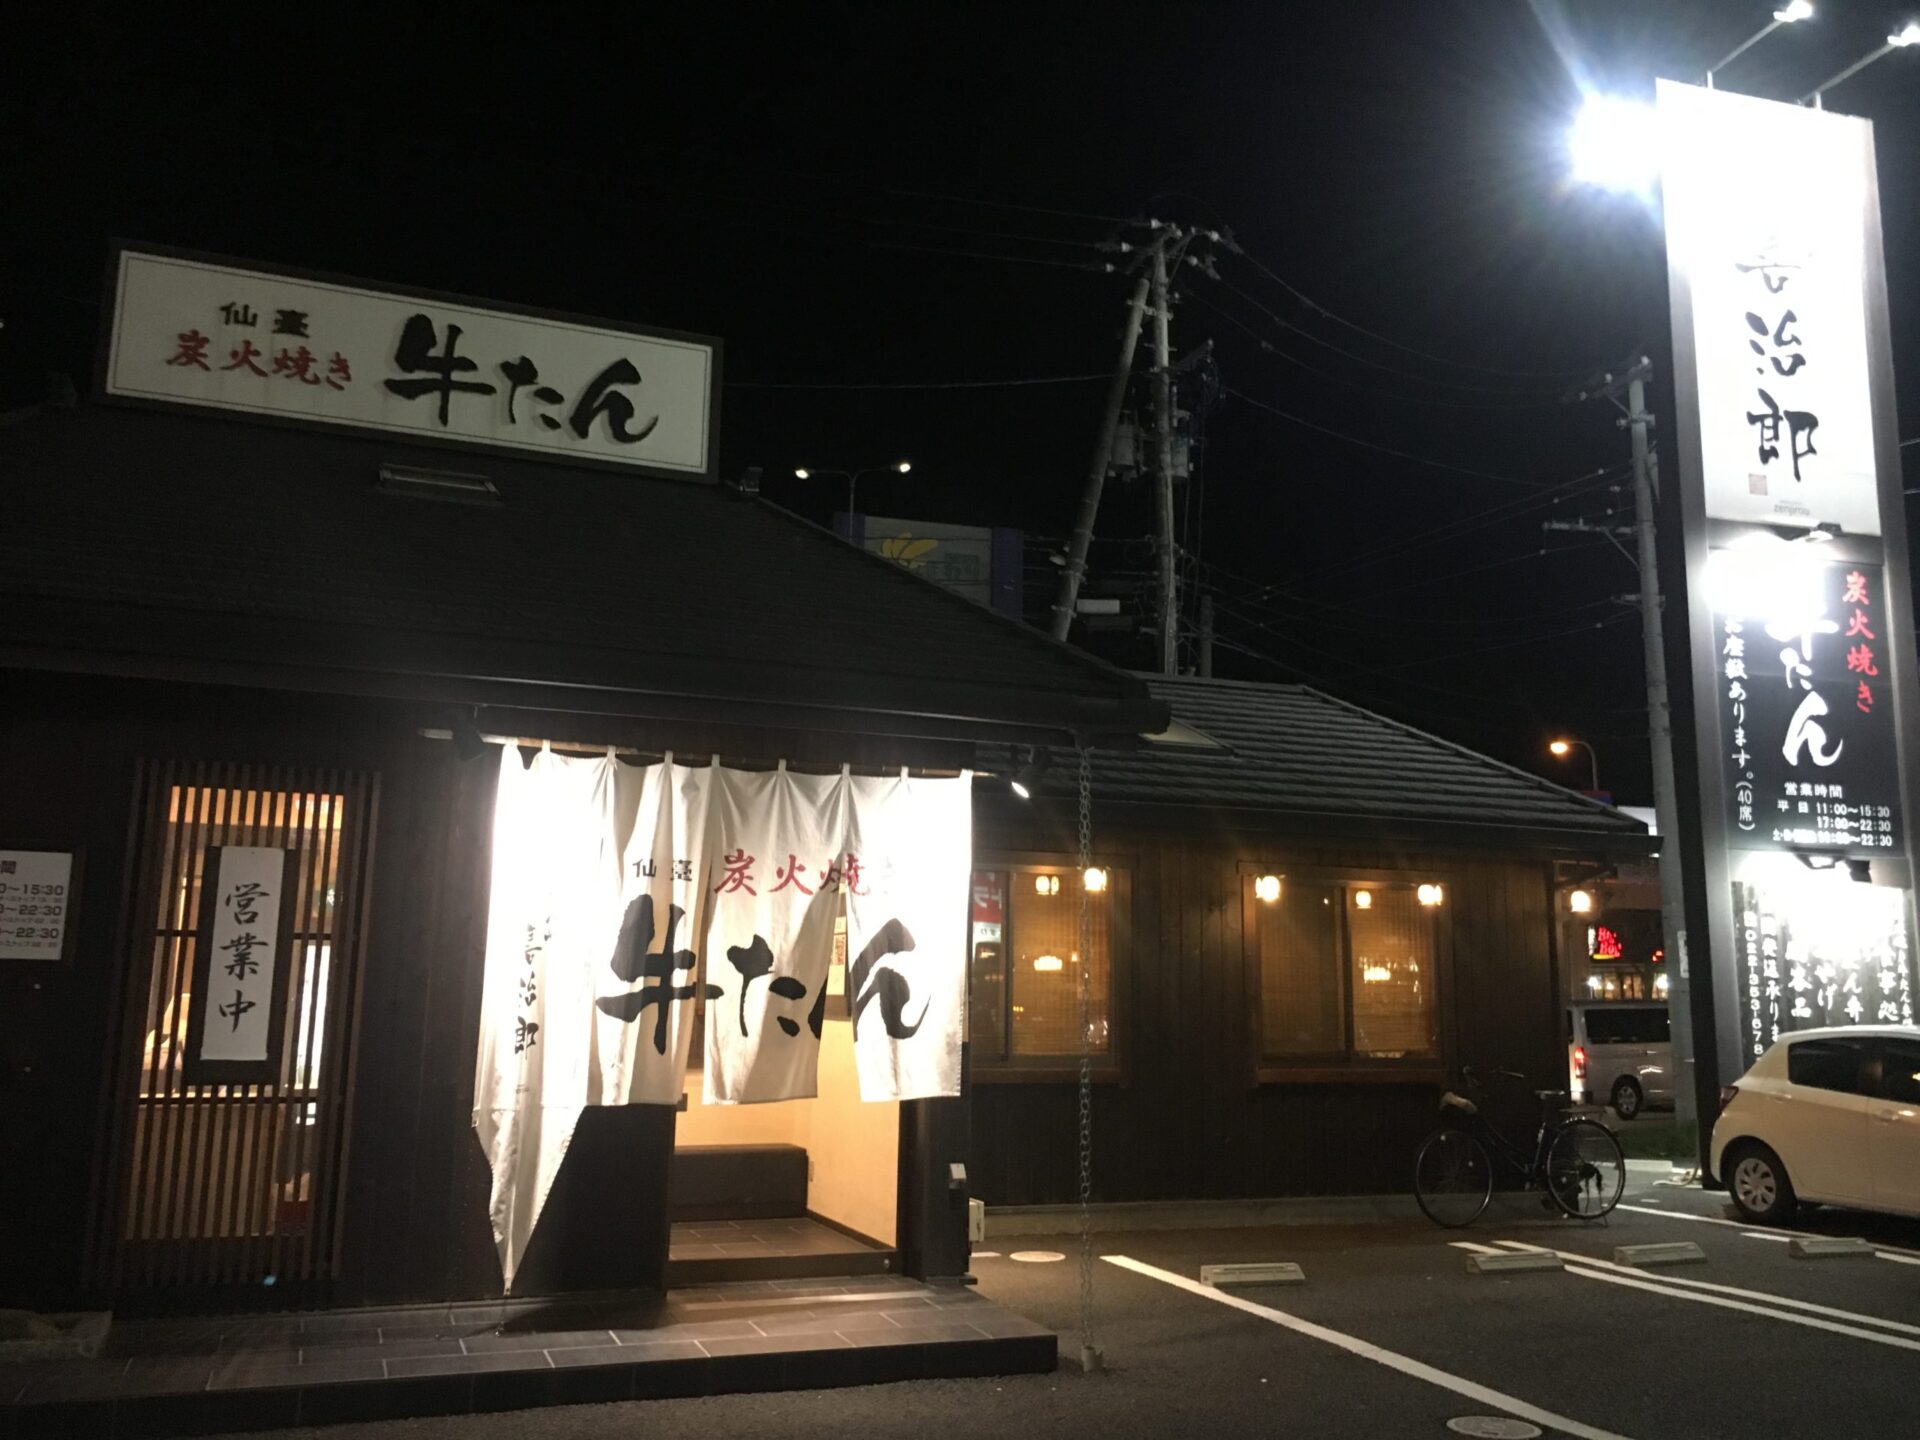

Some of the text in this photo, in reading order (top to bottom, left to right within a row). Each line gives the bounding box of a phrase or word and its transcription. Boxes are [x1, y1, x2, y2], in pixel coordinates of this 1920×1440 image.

[164, 329, 353, 391] 炭火焼き
[383, 313, 660, 444] 牛たん
[1841, 570, 1879, 714] 炭火焼き
[1783, 781, 1843, 799] 営業時間
[713, 848, 890, 897] 炭火焼
[218, 882, 271, 1034] 営業中
[594, 893, 932, 1056] 牛たん
